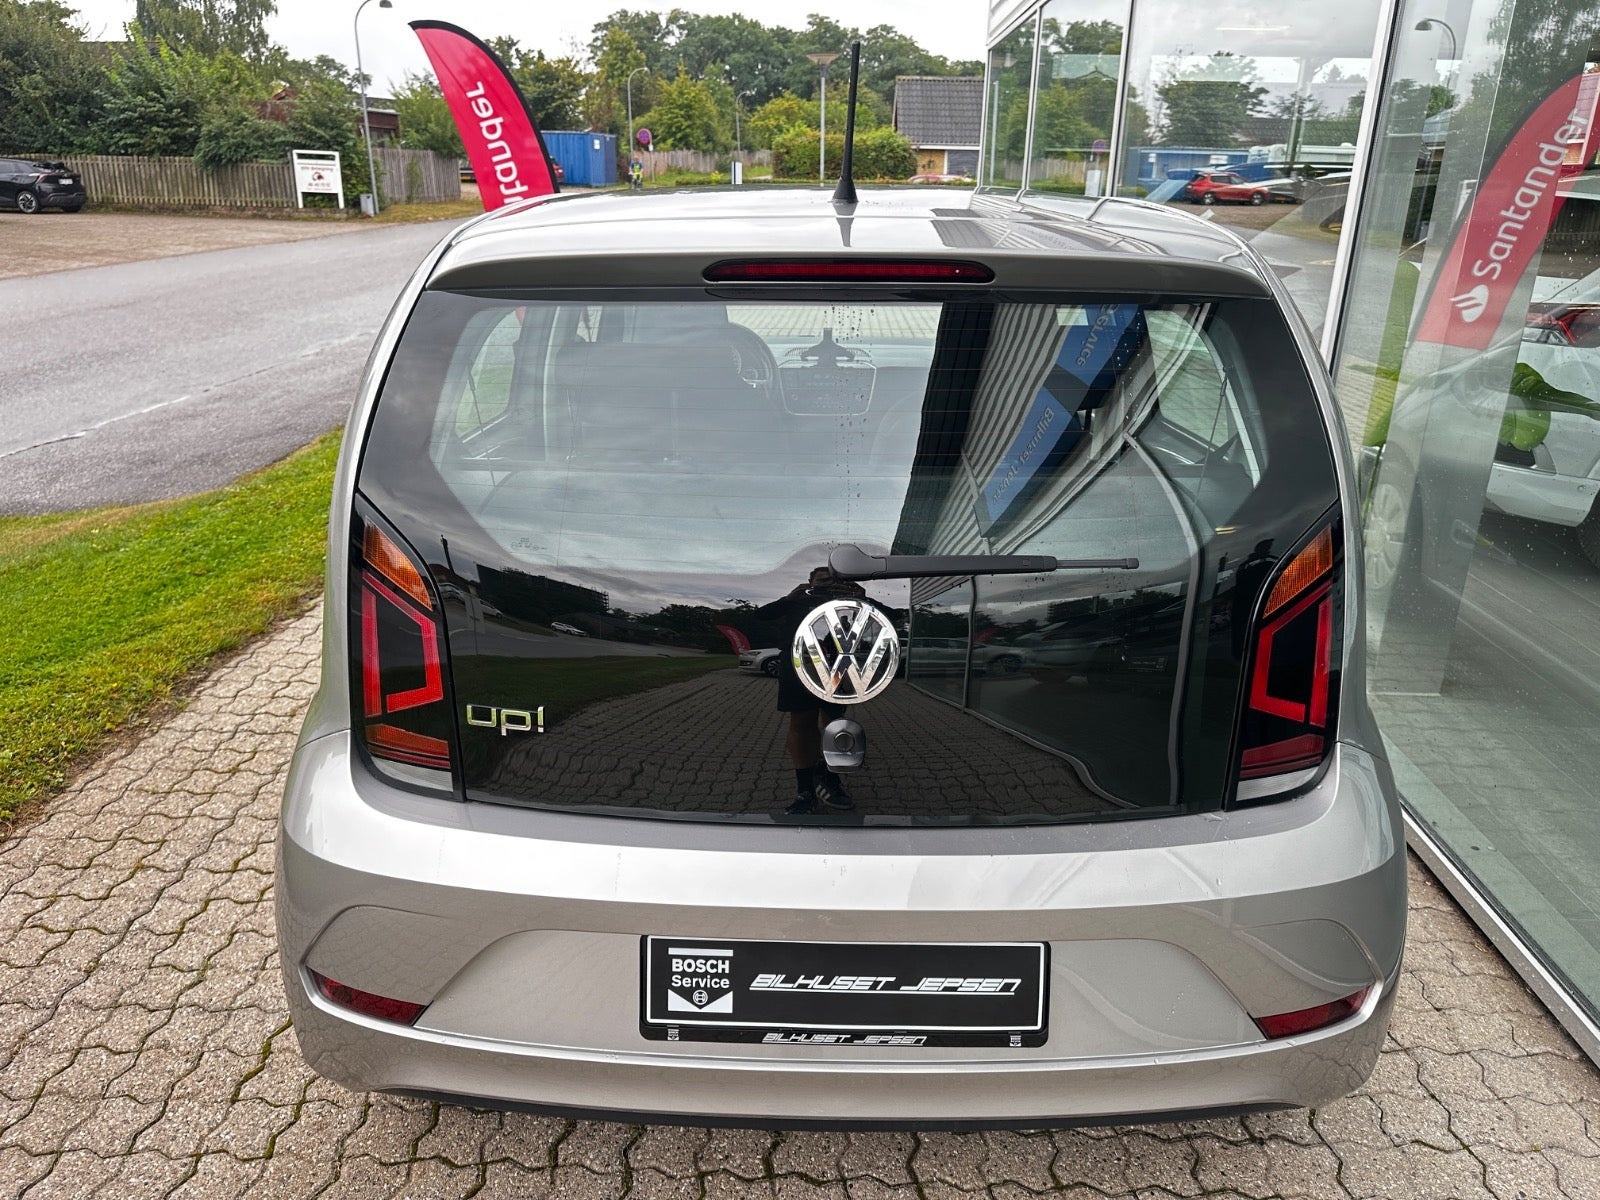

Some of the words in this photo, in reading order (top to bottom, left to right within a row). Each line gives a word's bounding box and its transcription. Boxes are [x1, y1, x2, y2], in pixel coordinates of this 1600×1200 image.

[1472, 108, 1589, 280] Santander
[466, 704, 544, 736] up!
[671, 958, 730, 974] BOSCH
[671, 975, 730, 989] Service
[750, 973, 896, 990] BILHUSET
[900, 977, 1021, 992] JEPSEN
[762, 1032, 851, 1043] BILHUSET
[853, 1035, 928, 1045] JEPSEN
